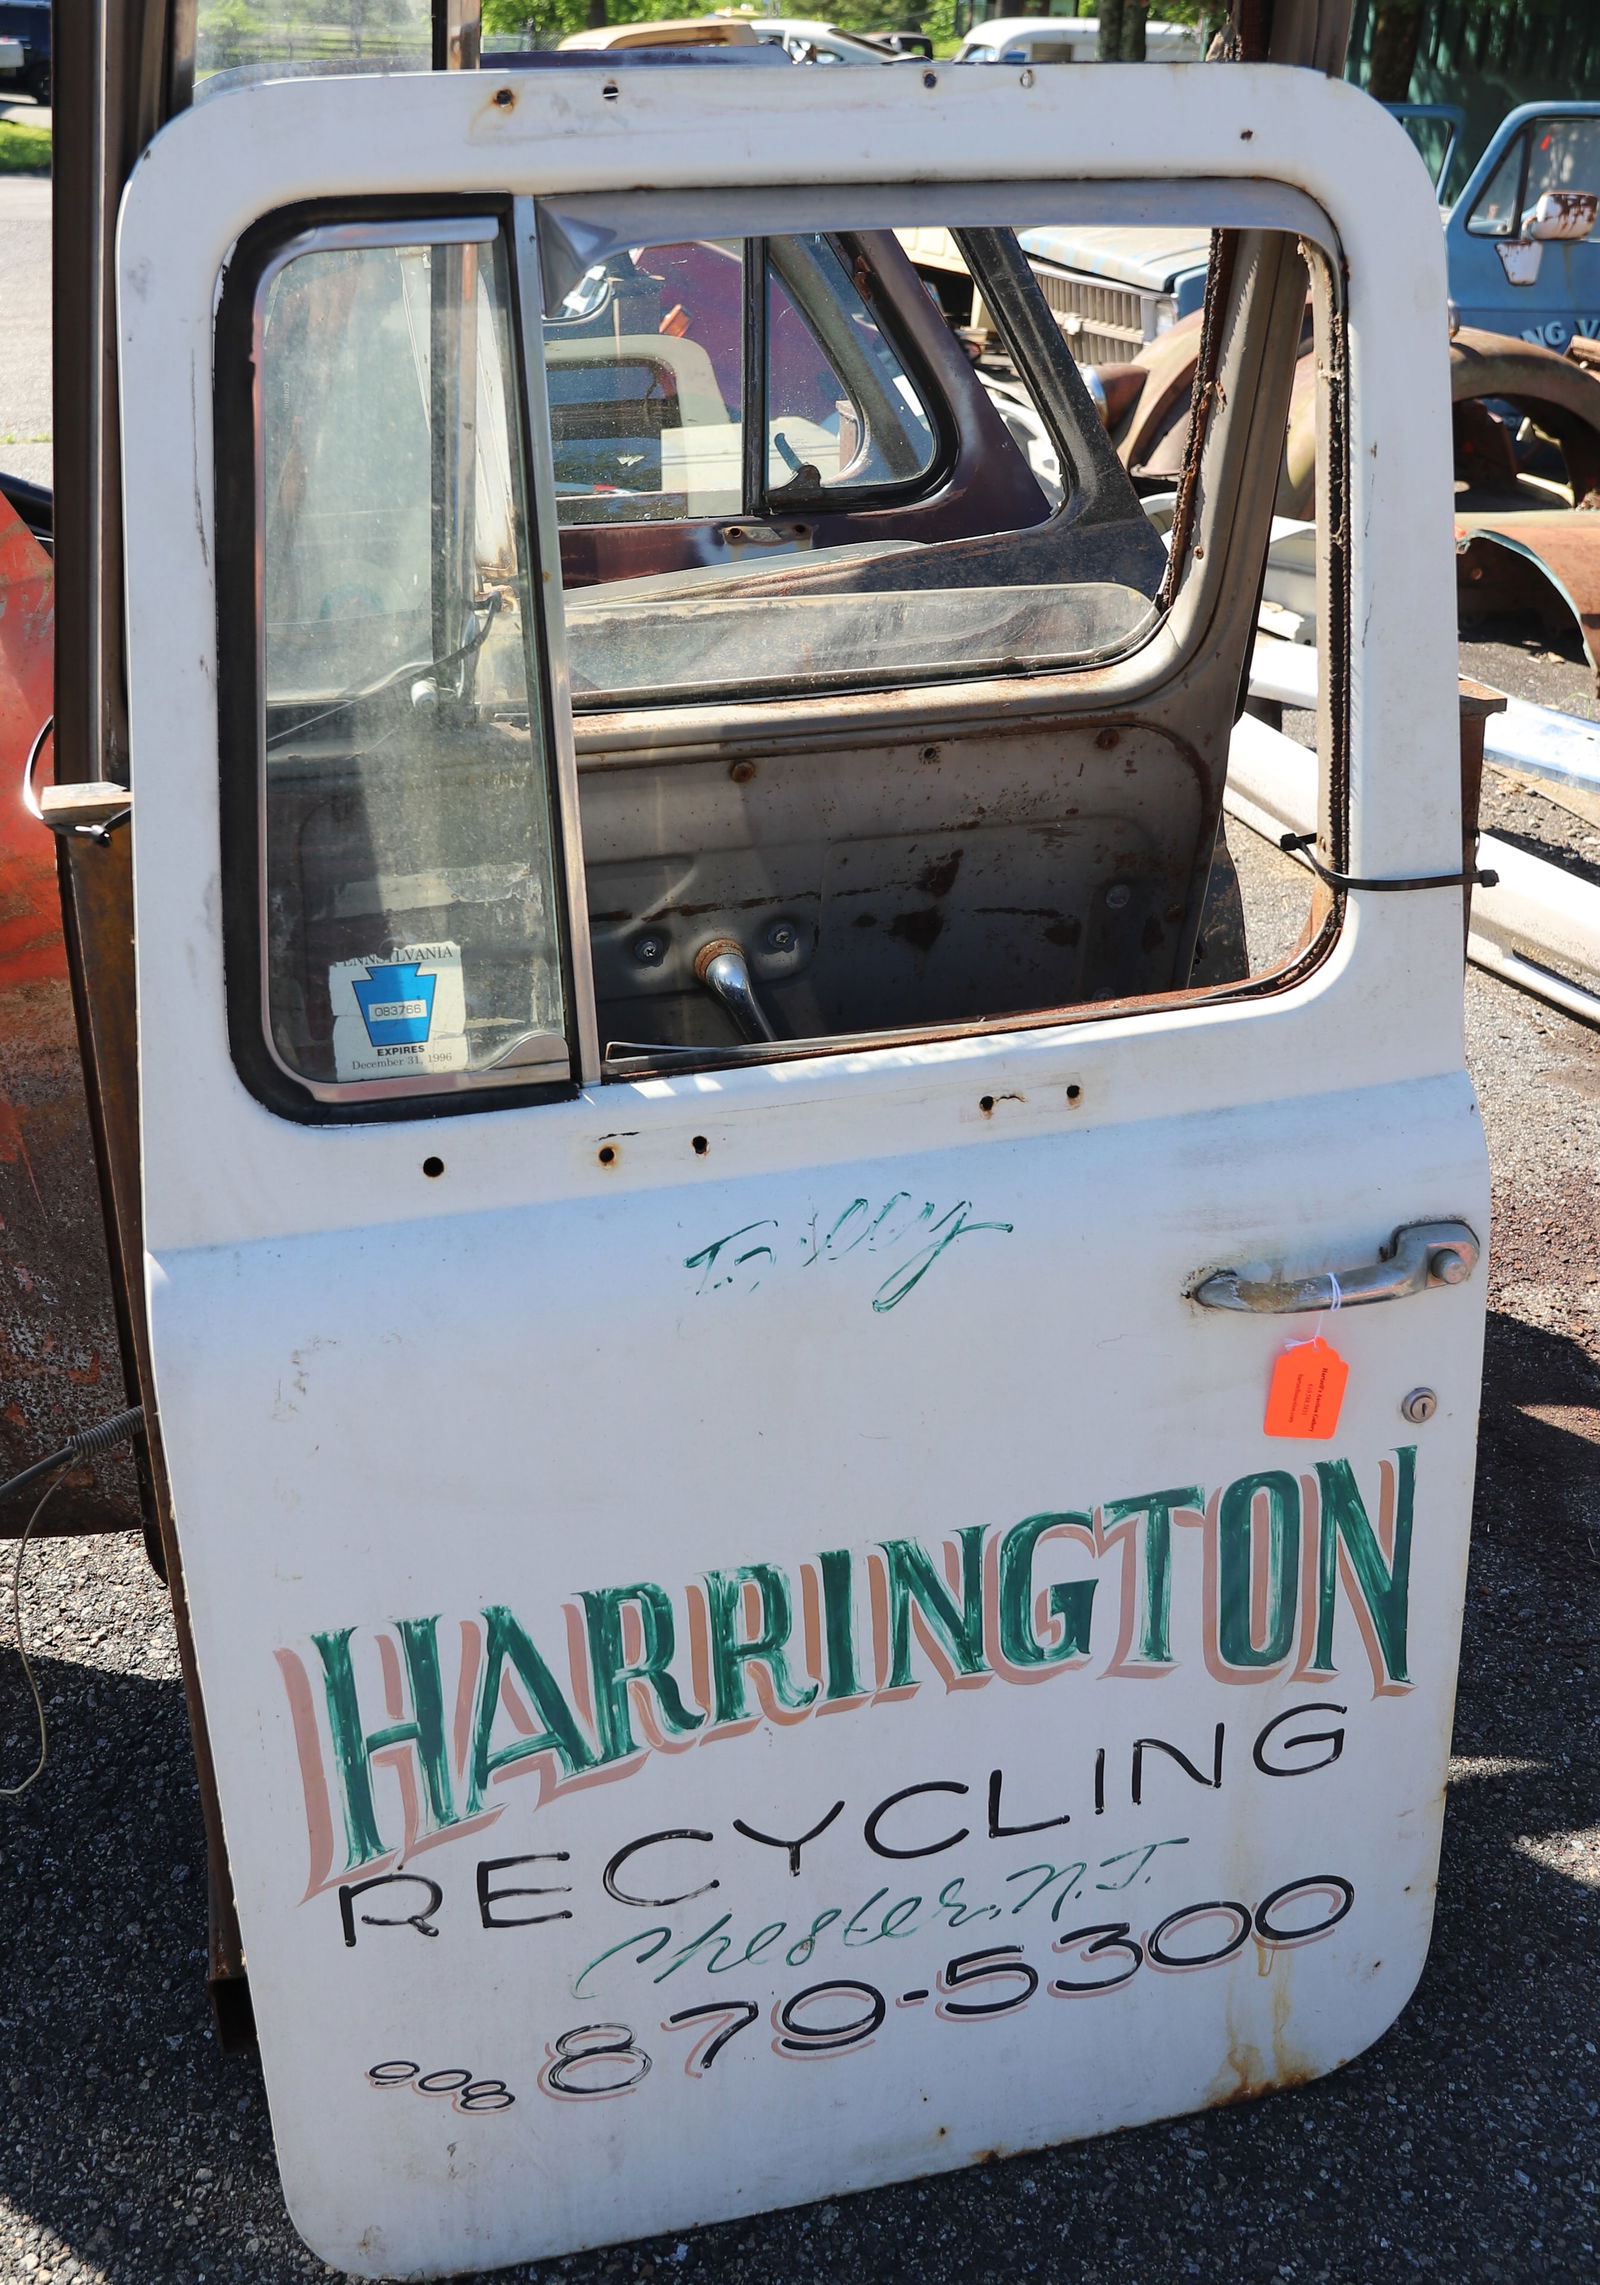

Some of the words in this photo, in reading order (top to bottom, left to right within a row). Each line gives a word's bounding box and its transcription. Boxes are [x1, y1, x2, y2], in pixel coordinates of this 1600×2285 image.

[352, 1058, 404, 1070] December
[408, 1055, 424, 1066] 31,
[428, 1053, 452, 1063] 1996
[377, 1045, 425, 1057] EXPIRES
[273, 1445, 1418, 1906] HARRINGTON
[339, 1703, 1347, 1947] RECYCLING
[1007, 1837, 1189, 1922] N.J.
[540, 1876, 1354, 2102] 870-5300
[355, 2060, 516, 2116] 908
